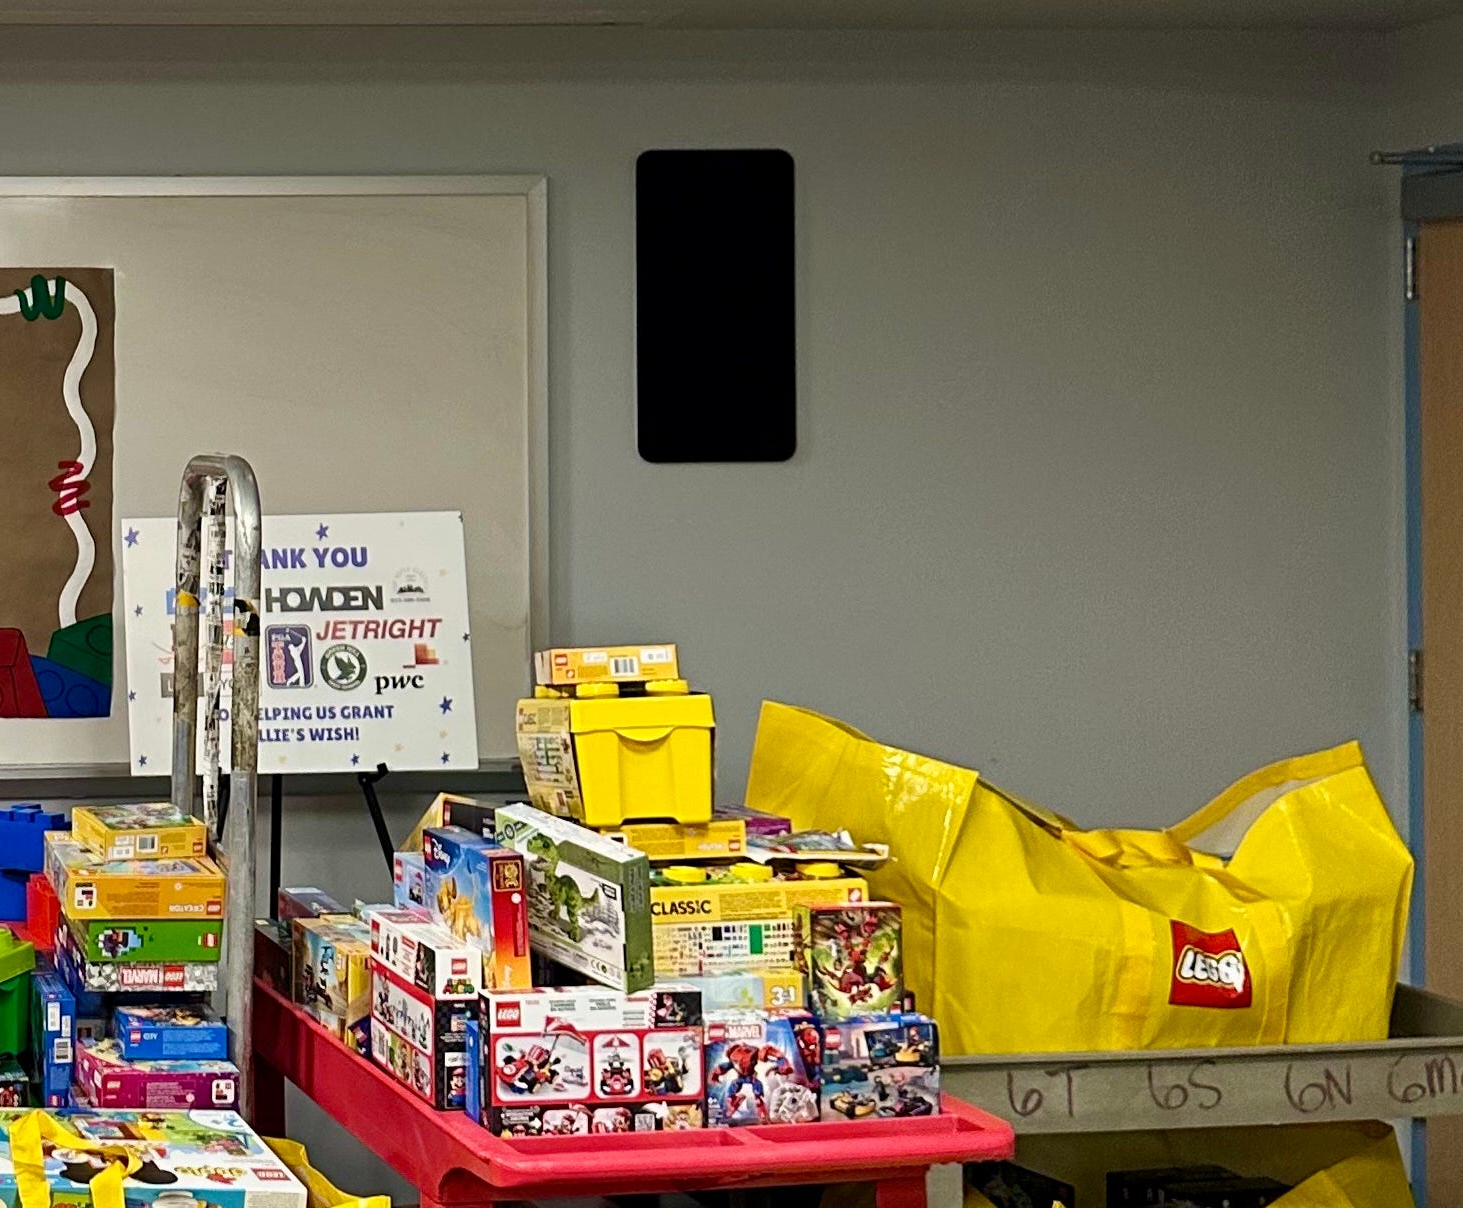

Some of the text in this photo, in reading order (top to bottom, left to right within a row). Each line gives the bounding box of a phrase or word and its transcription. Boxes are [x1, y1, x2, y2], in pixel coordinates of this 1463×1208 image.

[220, 547, 368, 569] TANK YOU
[266, 586, 383, 612] HOWDEN
[316, 619, 442, 641] JETRIGHT
[374, 674, 425, 695] pwc
[256, 704, 394, 721] ELPING US GRANT
[259, 726, 359, 742] LLIE'S WISH!
[651, 900, 712, 916] CLASSIC
[122, 968, 159, 985] MARVEL
[1179, 948, 1245, 993] LEGO
[498, 1009, 519, 1019] LEGO
[728, 1025, 760, 1040] MARVEL
[1006, 1054, 1463, 1118] 6T 6S 6N 6M
